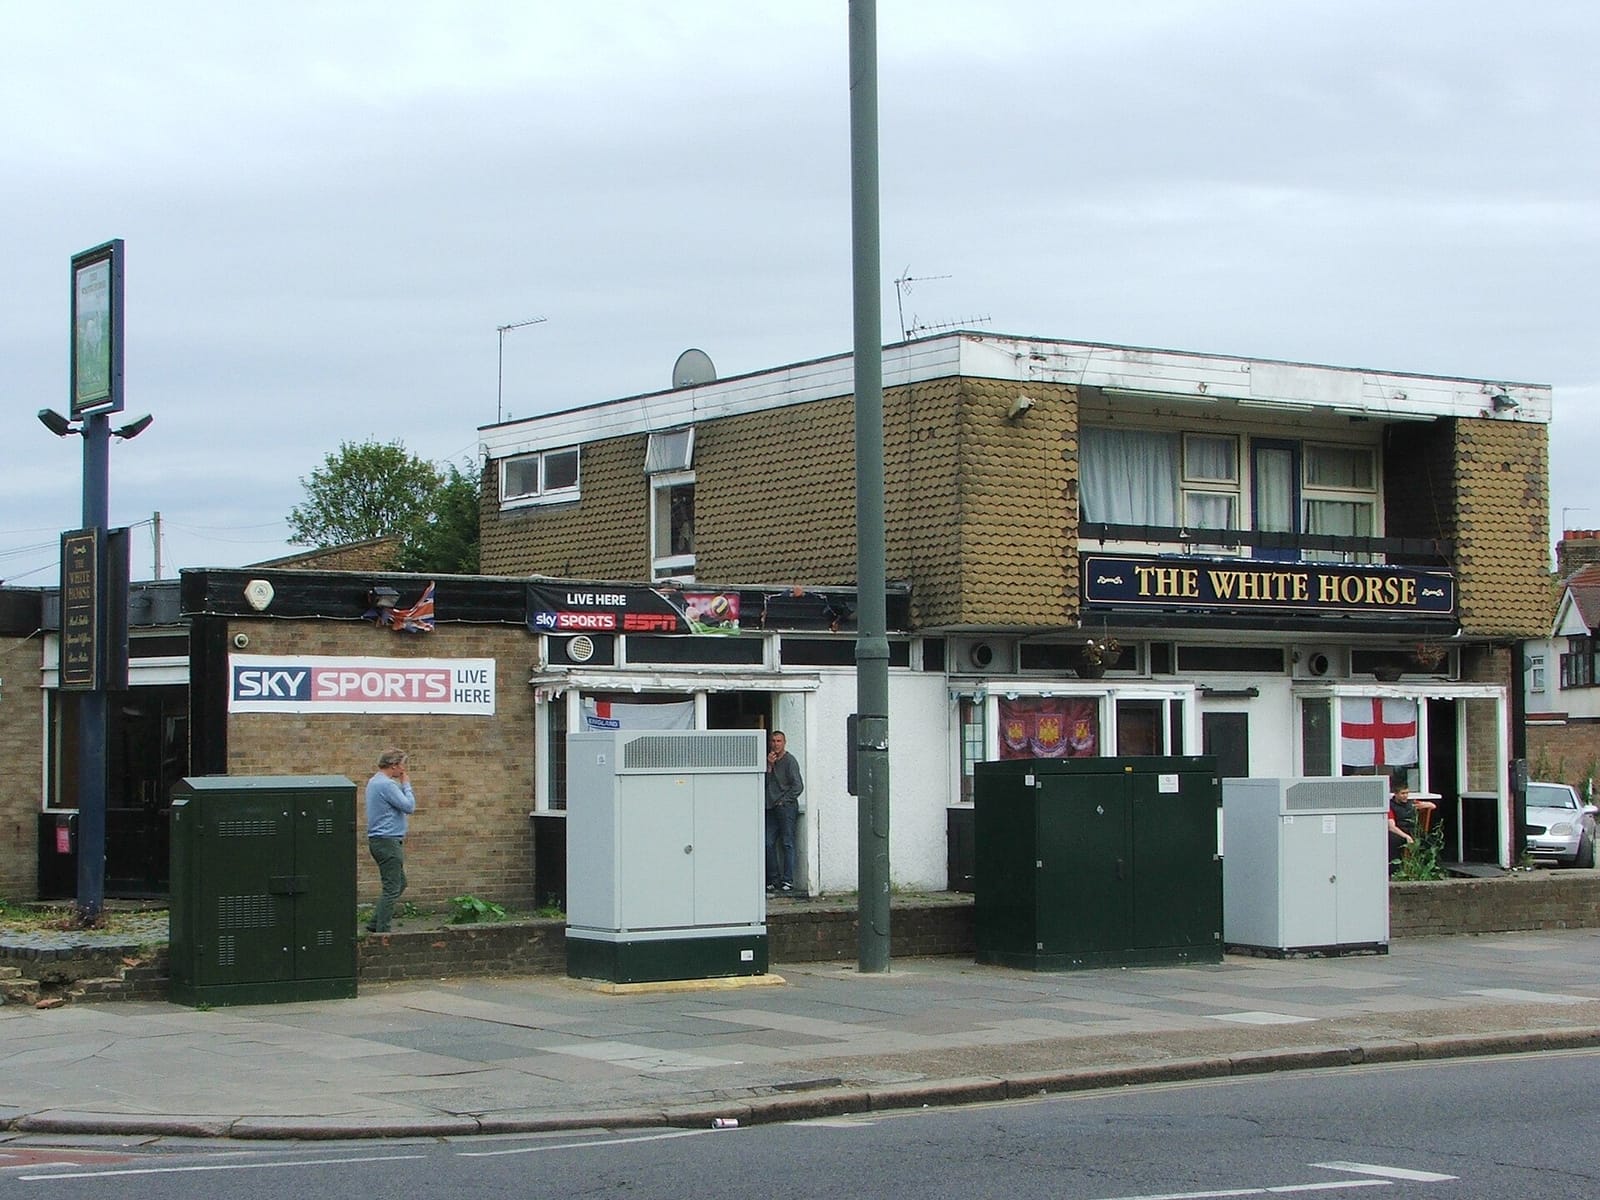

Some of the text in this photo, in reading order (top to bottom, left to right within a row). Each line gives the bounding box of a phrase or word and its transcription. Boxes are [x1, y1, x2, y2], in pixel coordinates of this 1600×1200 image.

[1134, 566, 1417, 605] THE WHITE HORSE
[567, 593, 627, 606] LIVE HERE
[535, 612, 677, 631] sky SPORTS ESPN
[457, 669, 488, 684] LIVE
[238, 671, 447, 698] SKY SPORTS
[453, 689, 491, 703] HERE
[588, 718, 618, 727] ENGLAND
